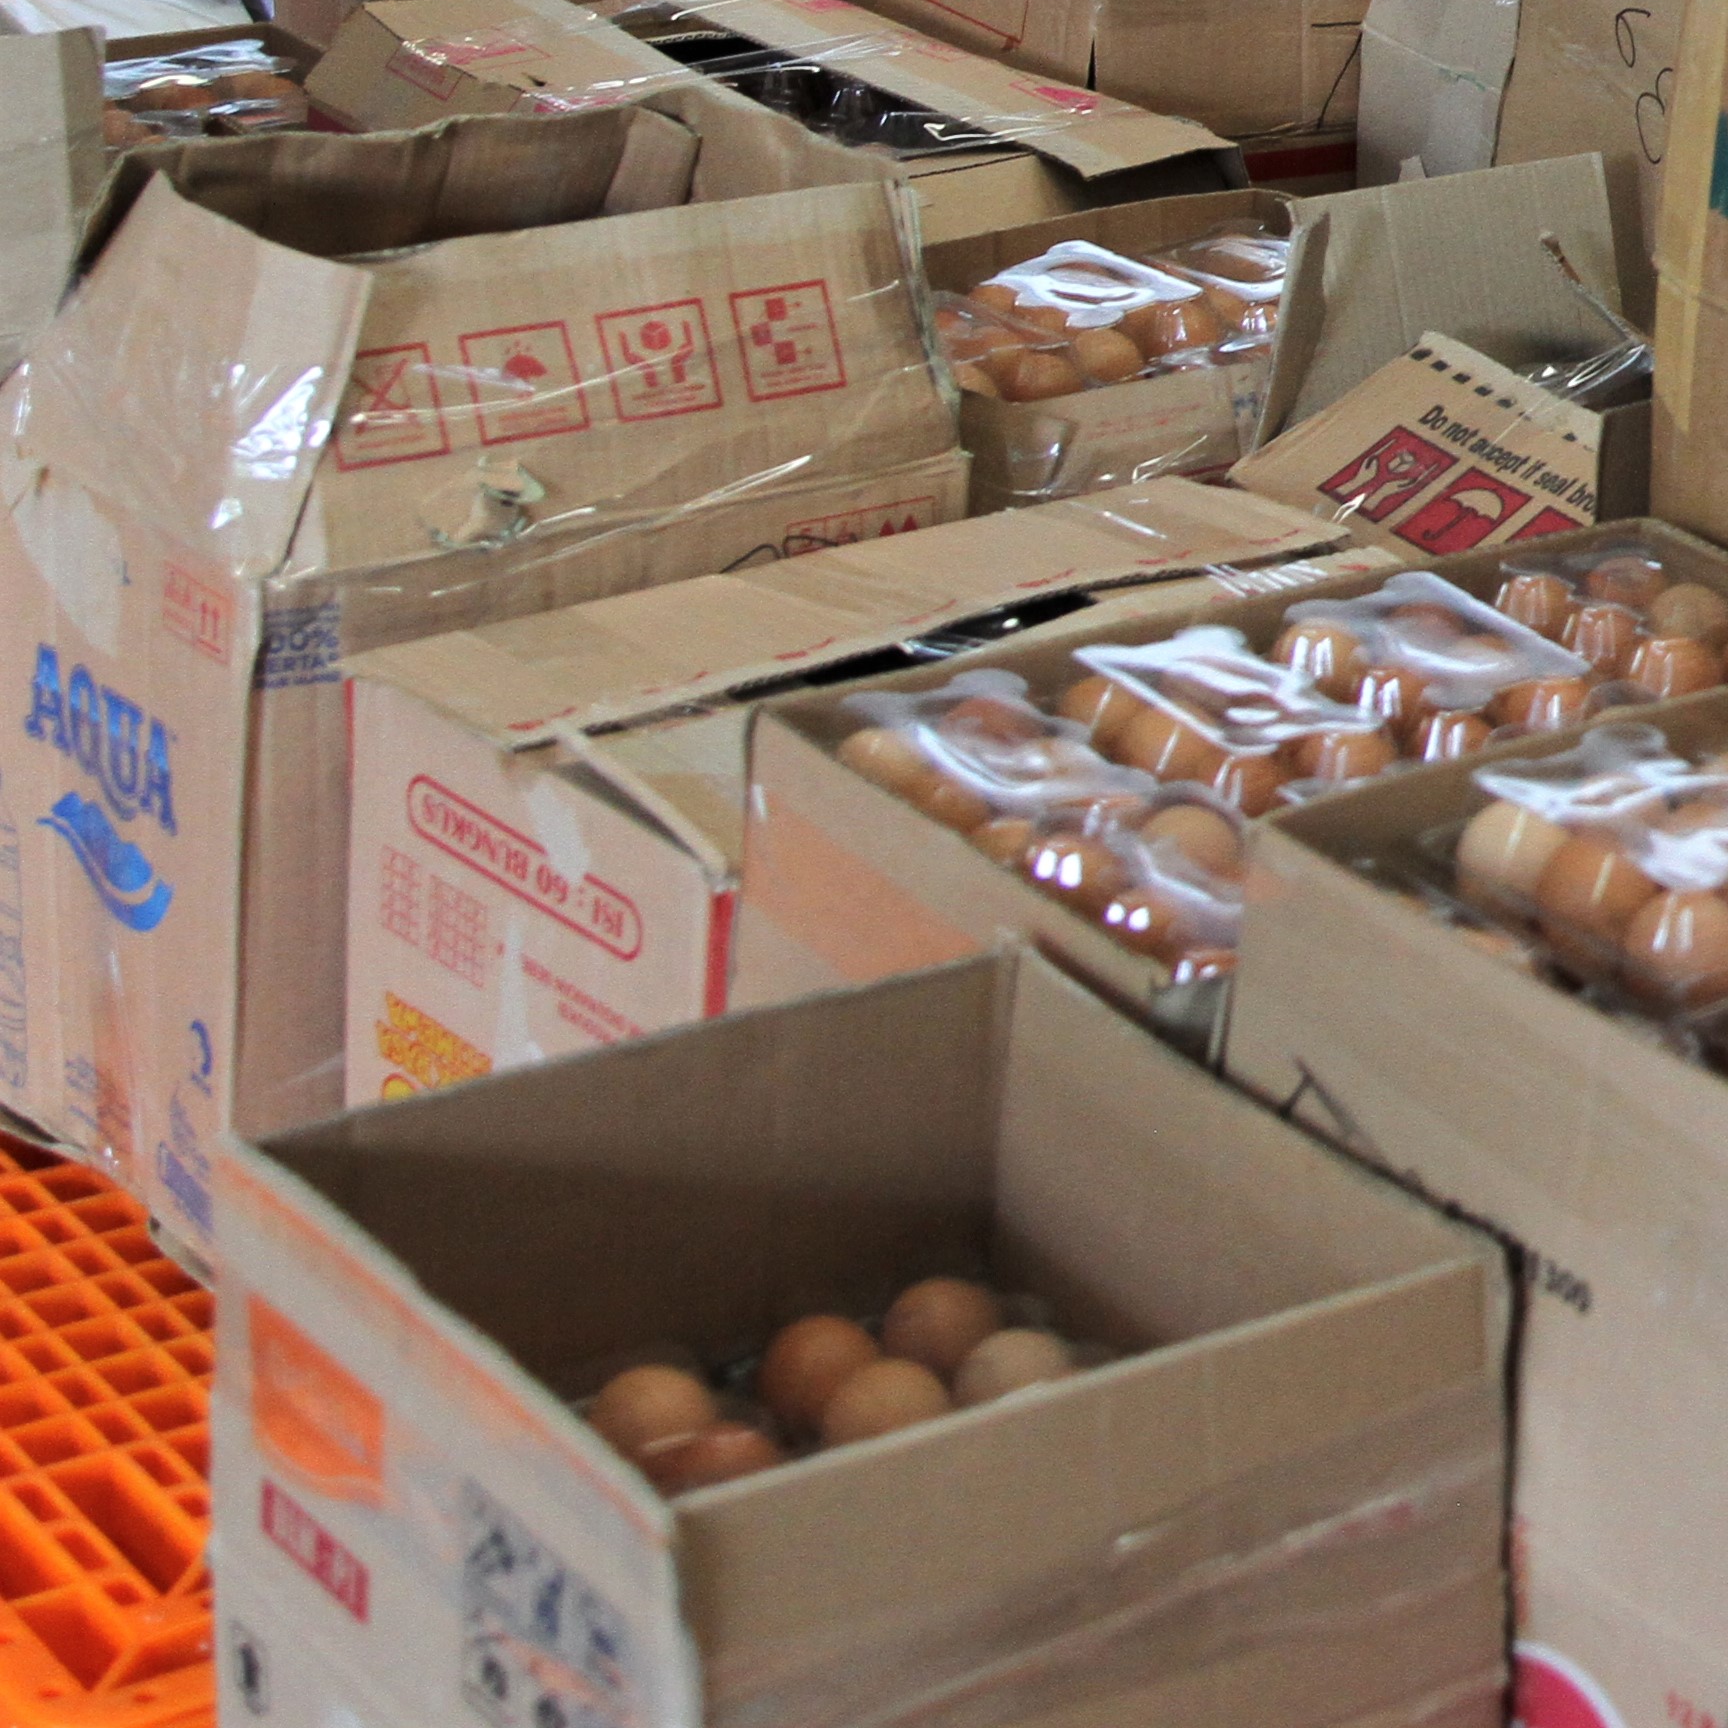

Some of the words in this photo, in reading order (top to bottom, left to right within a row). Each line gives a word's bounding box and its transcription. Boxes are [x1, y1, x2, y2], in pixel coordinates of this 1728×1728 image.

[1419, 404, 1448, 430] Do
[1441, 421, 1479, 447] not
[1520, 456, 1547, 481] if
[1533, 470, 1578, 497] seal
[25, 642, 178, 836] AQUA
